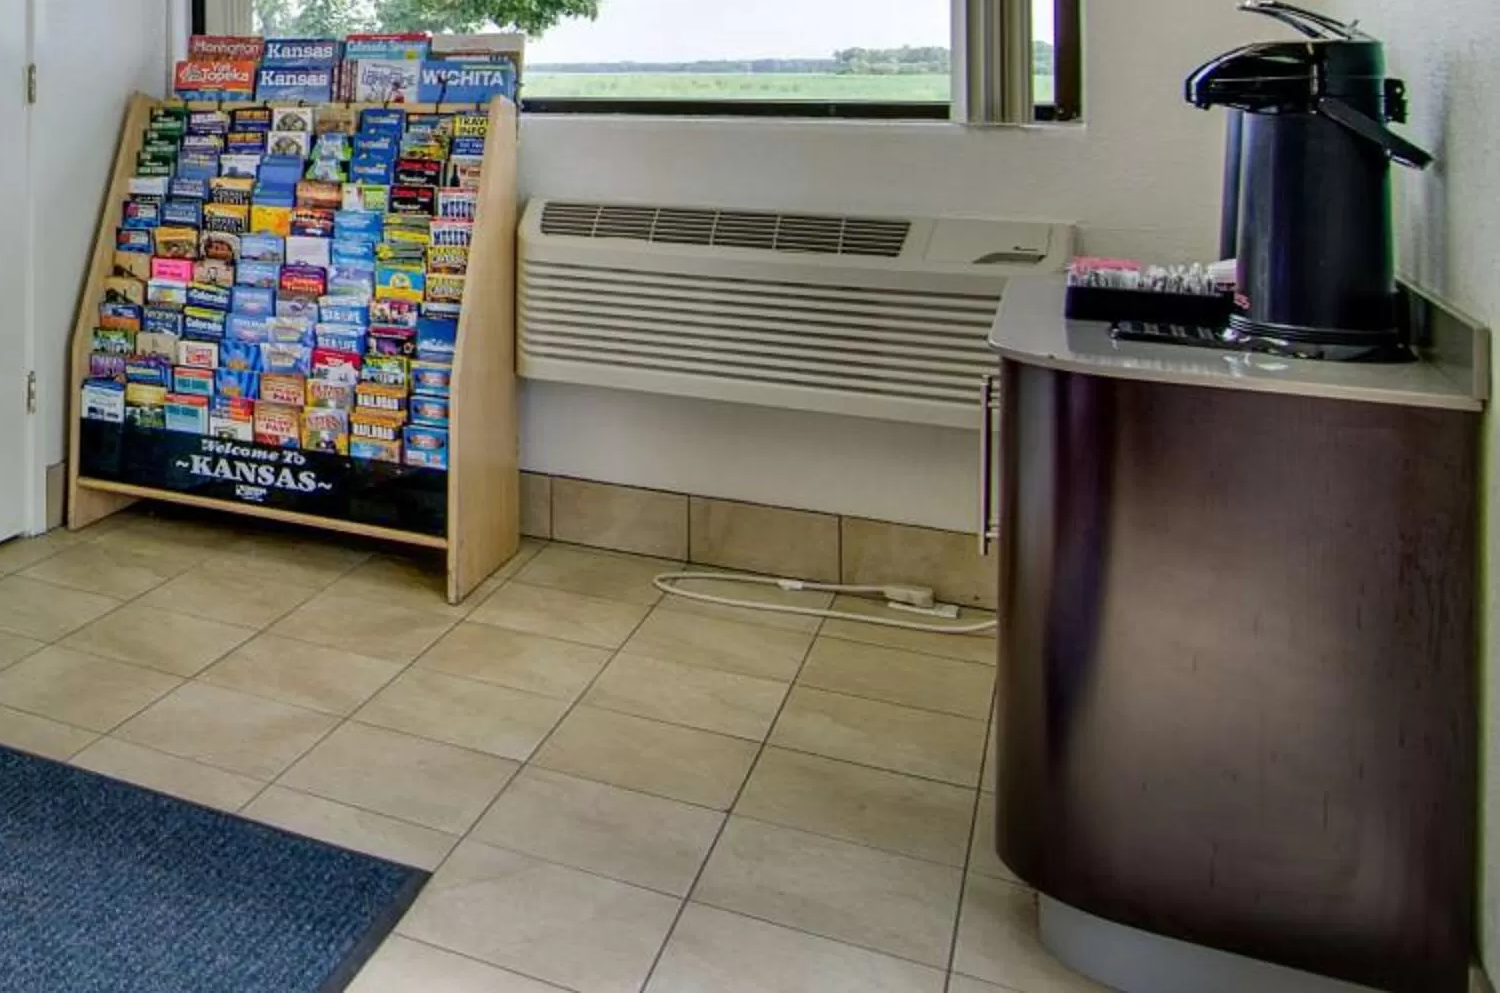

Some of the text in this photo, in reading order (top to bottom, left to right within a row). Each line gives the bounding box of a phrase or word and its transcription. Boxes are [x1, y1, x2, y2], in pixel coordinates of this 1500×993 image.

[268, 43, 333, 58] Kansas
[201, 68, 249, 83] Topeka
[260, 70, 327, 86] Kansas
[201, 438, 306, 466] Welcome To
